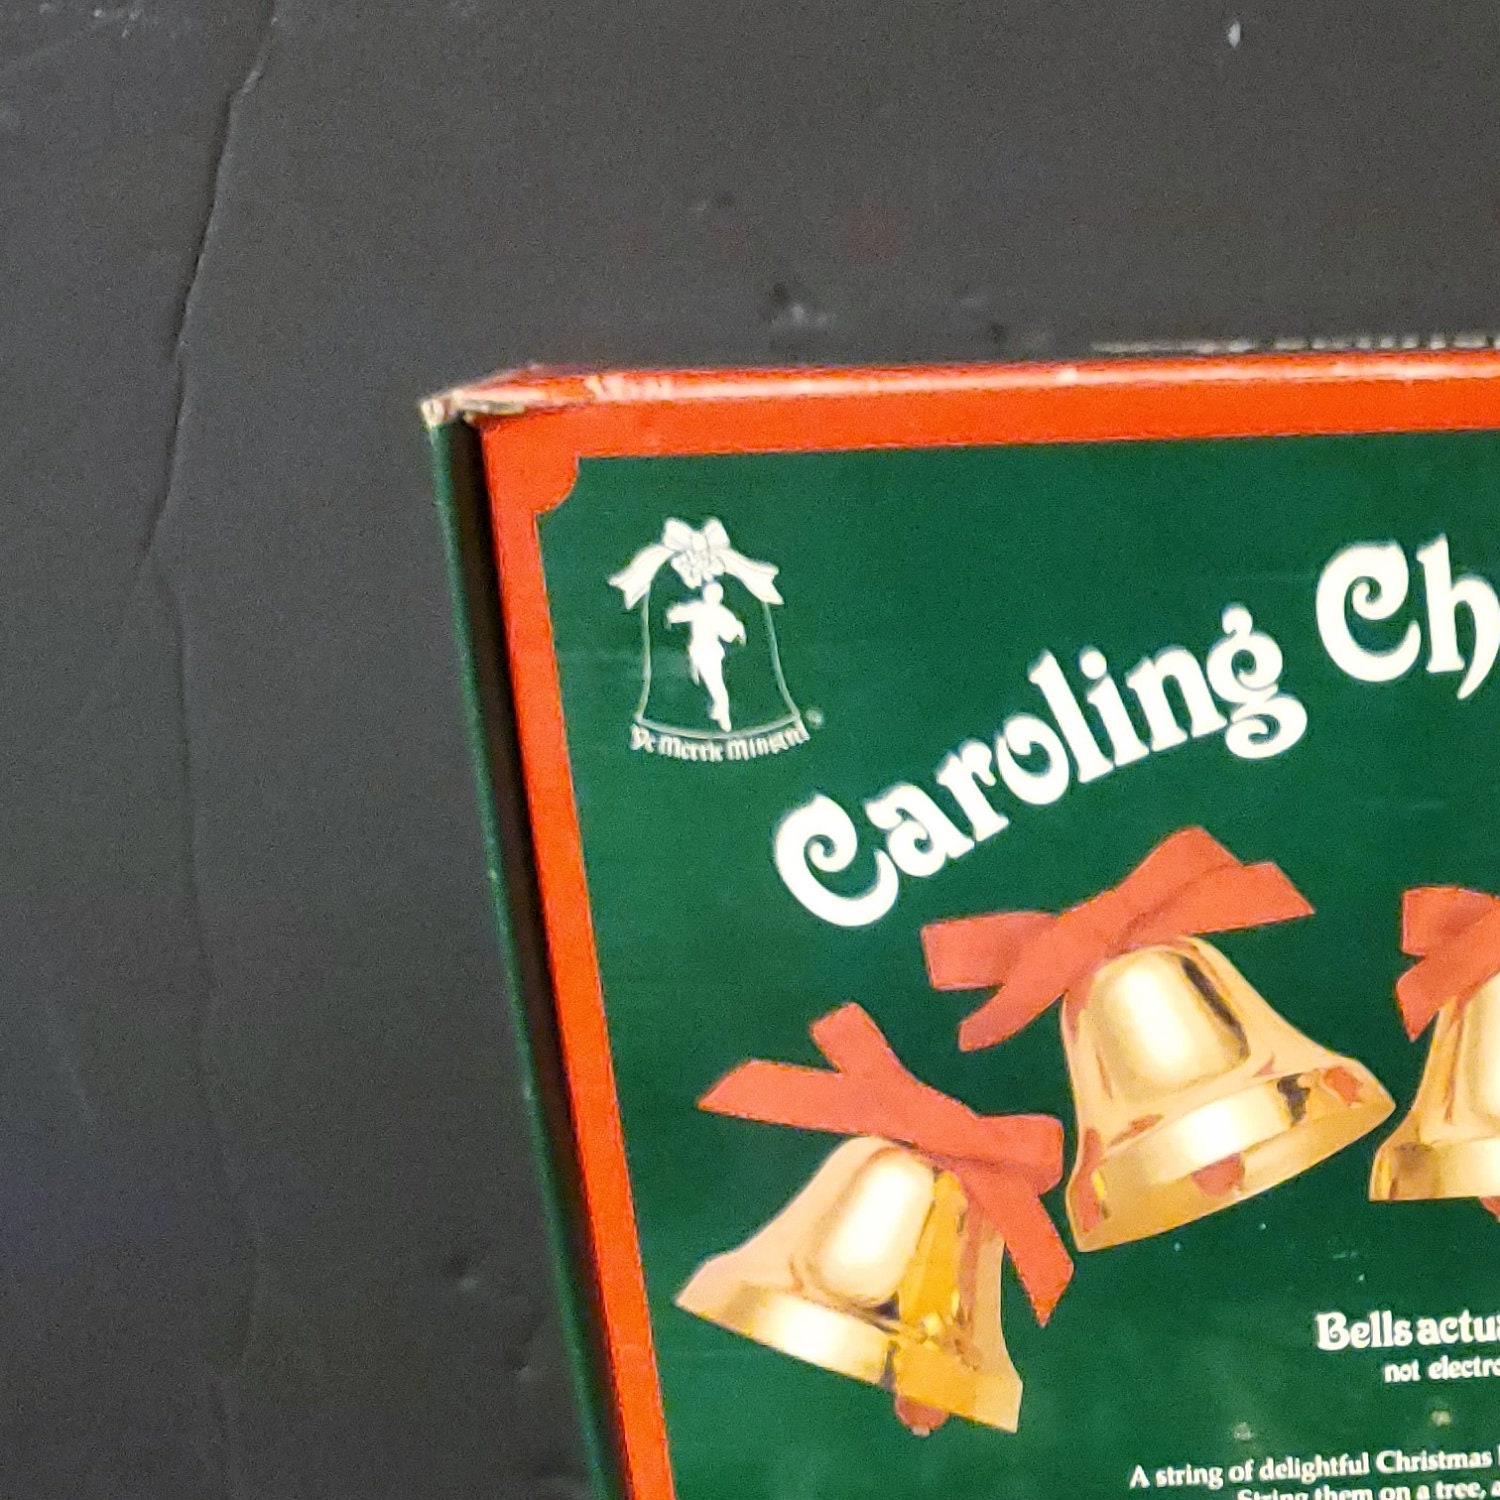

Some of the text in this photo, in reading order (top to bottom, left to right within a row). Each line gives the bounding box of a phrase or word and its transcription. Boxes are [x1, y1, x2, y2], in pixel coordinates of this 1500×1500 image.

[775, 605, 1310, 927] Caroling
[1315, 1310, 1413, 1351] Bells
[1383, 1360, 1420, 1383] not
[1130, 1465, 1150, 1488] A
[1156, 1464, 1223, 1490] string
[1228, 1458, 1254, 1483] of
[1258, 1452, 1370, 1487] delightful
[1375, 1450, 1493, 1474] Christmas
[1435, 1481, 1486, 1500] tree,
